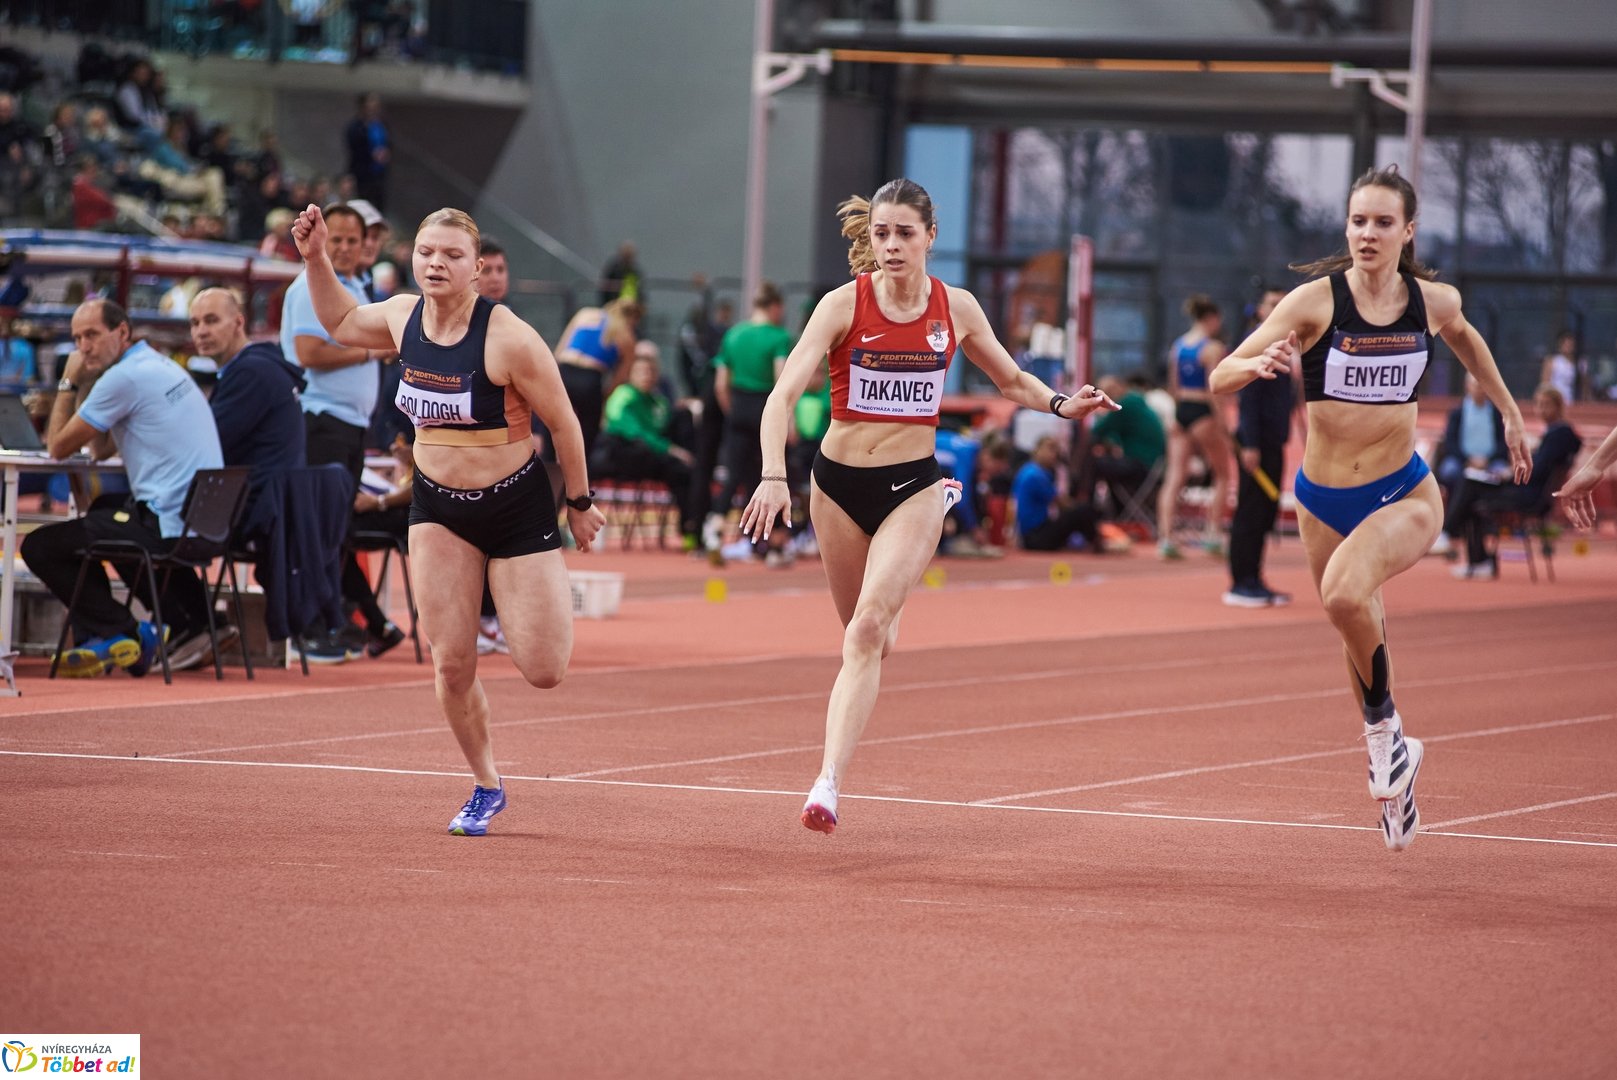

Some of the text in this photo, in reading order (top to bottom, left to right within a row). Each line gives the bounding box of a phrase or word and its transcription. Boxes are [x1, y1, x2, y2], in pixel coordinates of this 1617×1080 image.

[1358, 335, 1416, 344] FEDETTPÁLYÁS
[880, 354, 938, 362] FEDETTPÁLYÁS
[414, 370, 461, 383] FEDETTPÁLYÁS
[1344, 365, 1407, 386] ENYEDI
[860, 378, 933, 402] TAKAVEC
[401, 395, 462, 420] BOLDOGH
